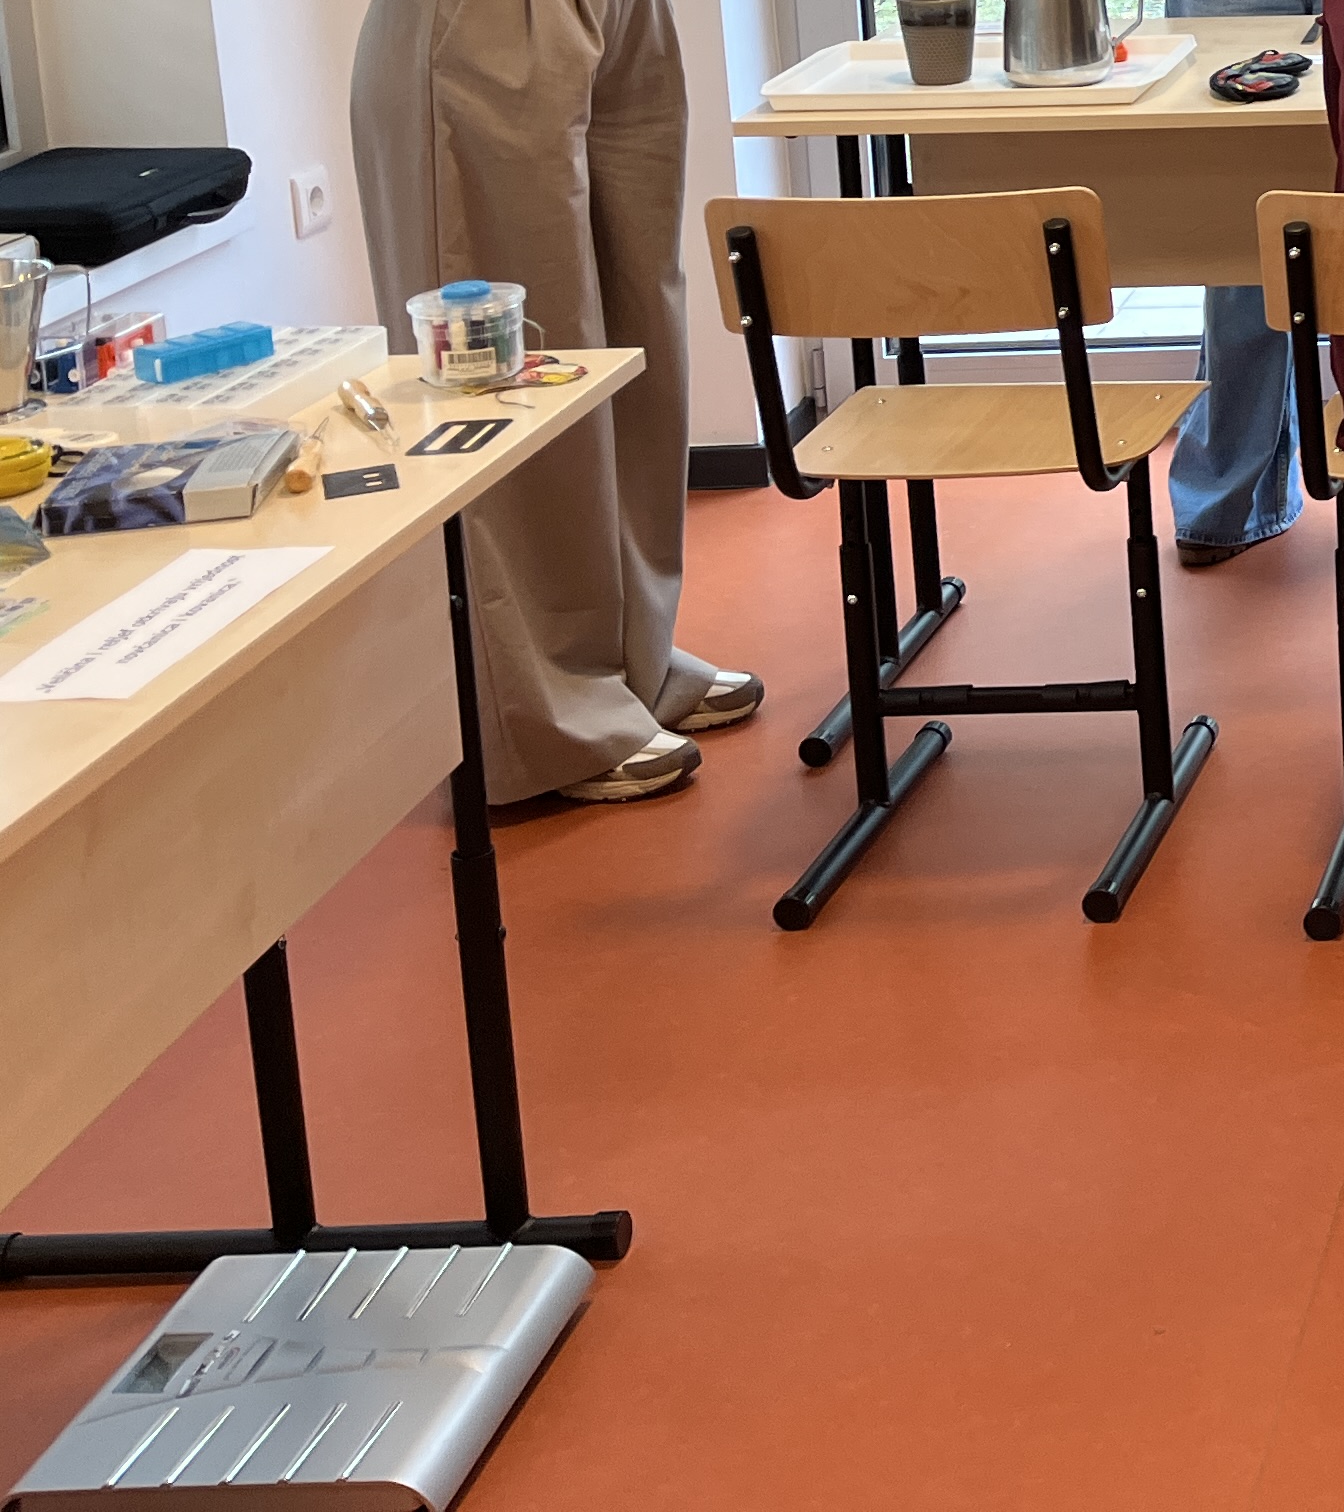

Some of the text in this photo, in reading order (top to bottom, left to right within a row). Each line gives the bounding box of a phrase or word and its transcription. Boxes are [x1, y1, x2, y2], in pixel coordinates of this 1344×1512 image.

[98, 627, 135, 652] reljef
[131, 591, 188, 629] otkrivaju
[183, 553, 246, 592] vrijednost
[116, 619, 182, 665] novčanica
